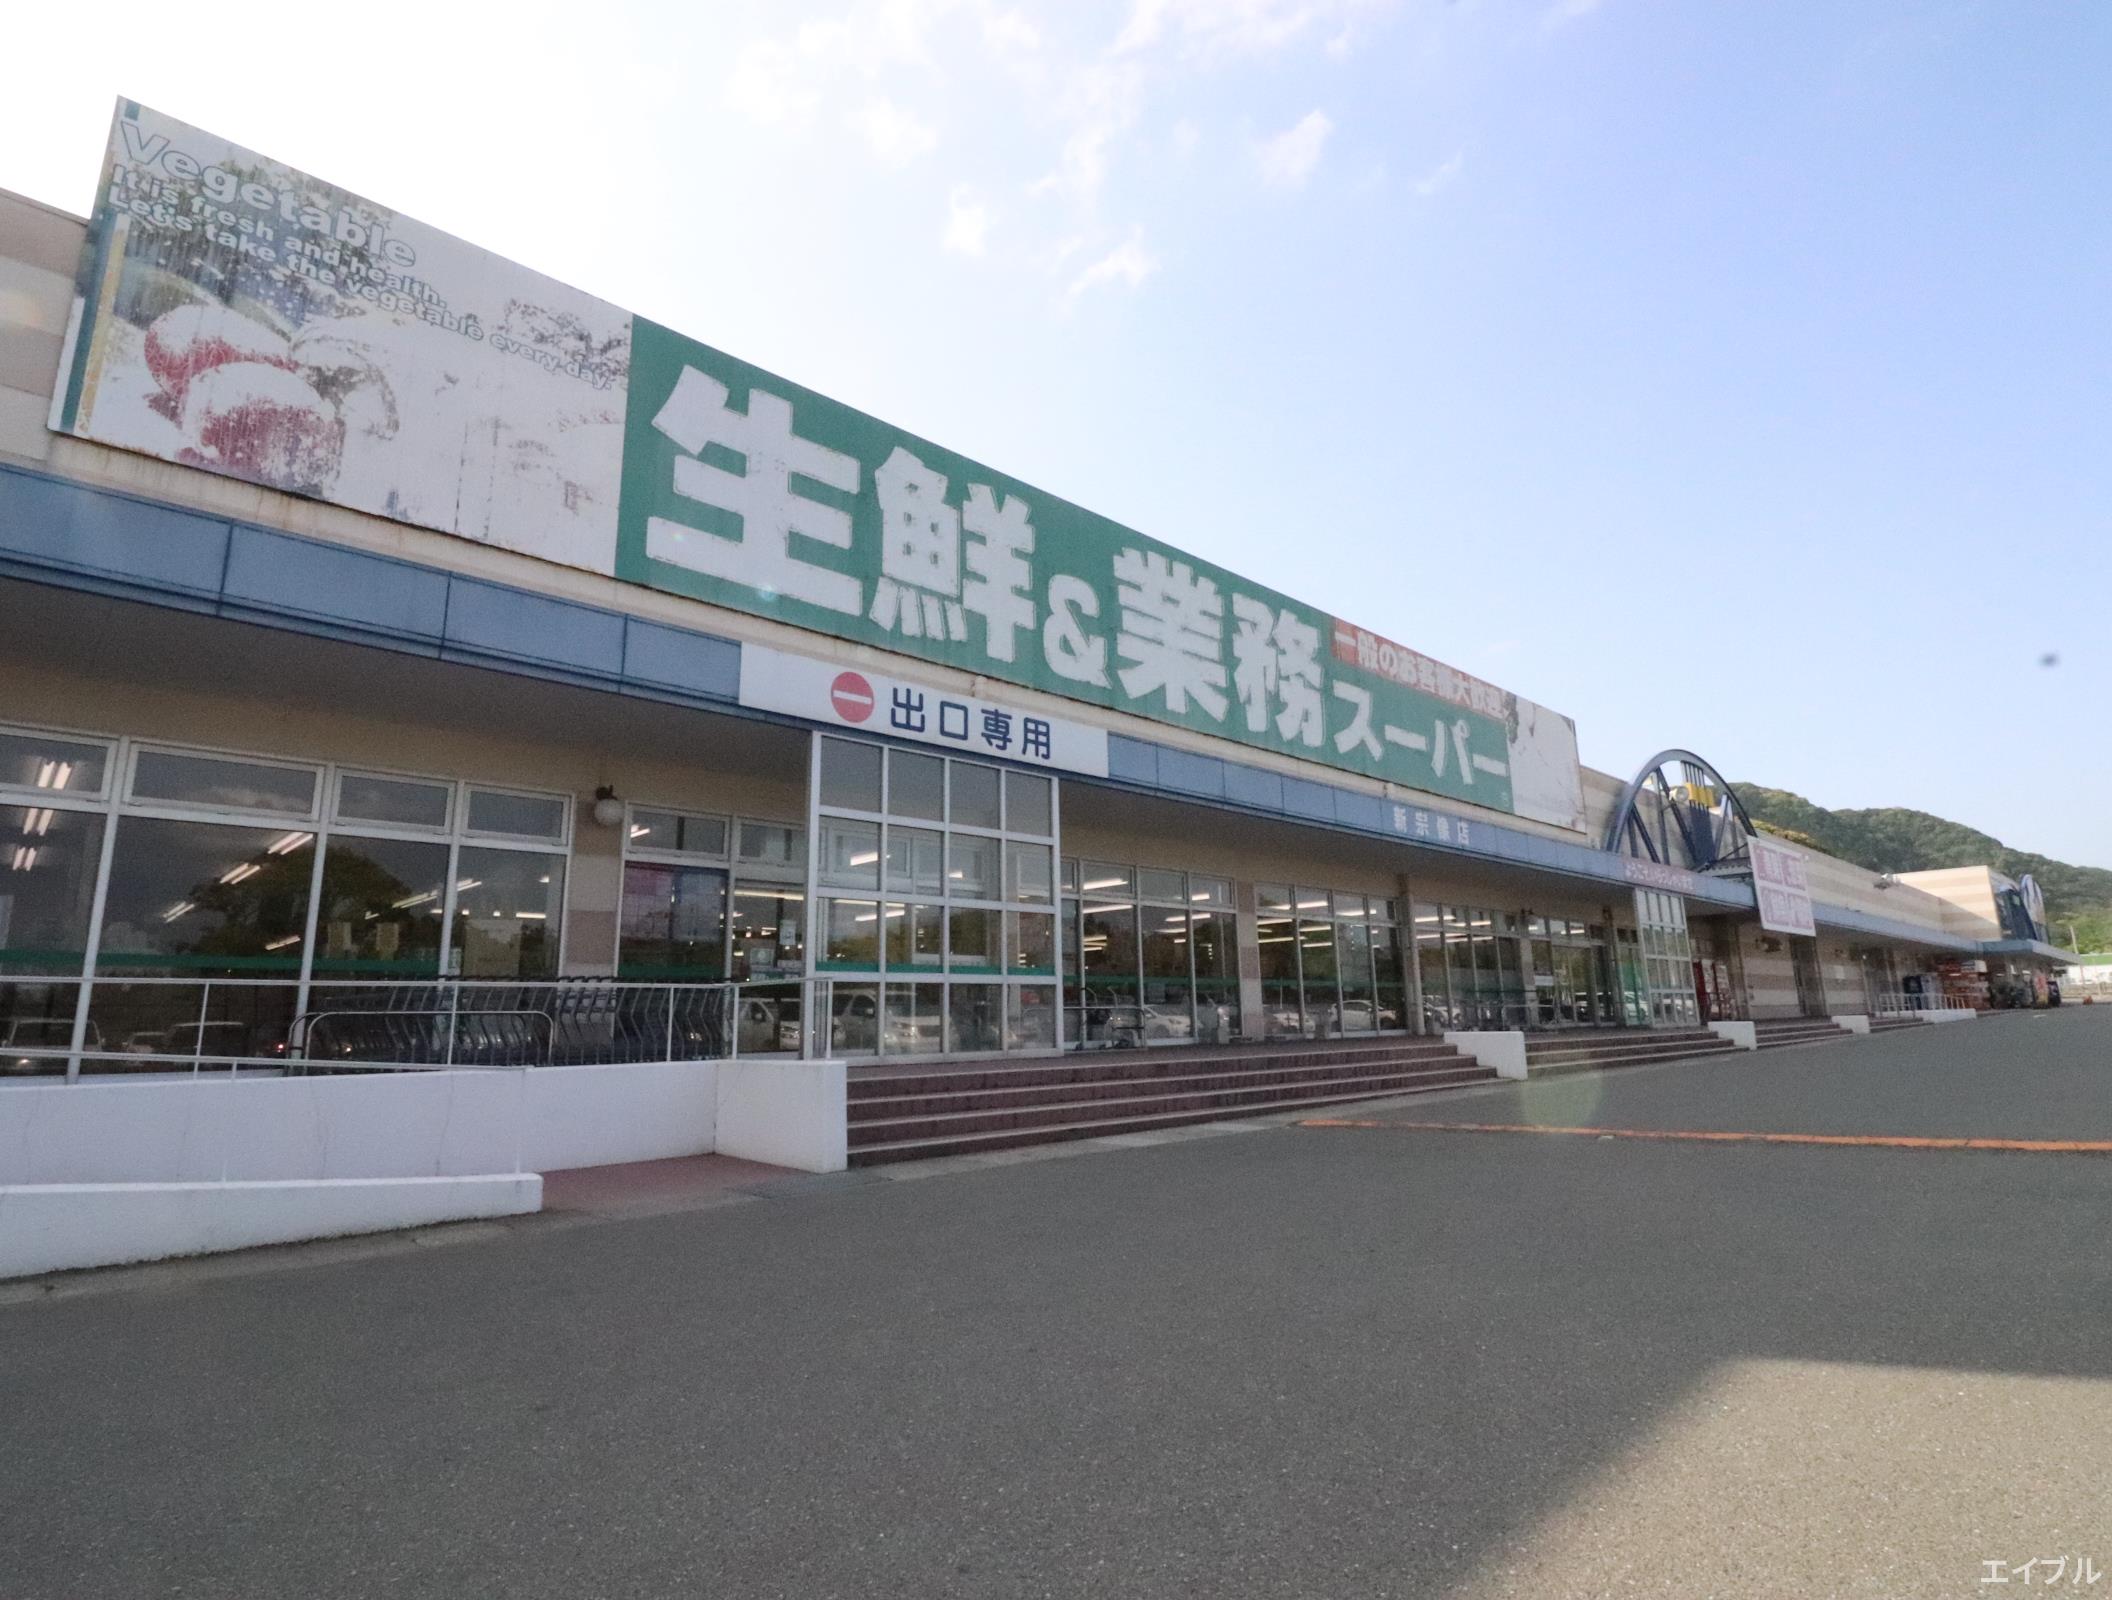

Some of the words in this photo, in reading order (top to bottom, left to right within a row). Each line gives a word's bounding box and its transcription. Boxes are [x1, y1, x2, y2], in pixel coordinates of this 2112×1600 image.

[113, 164, 140, 190] It
[150, 177, 179, 205] is
[191, 196, 274, 241] fresh
[284, 235, 341, 266] and
[350, 255, 447, 308] health.
[120, 120, 416, 267] Vegetable
[205, 223, 276, 261] take
[286, 253, 336, 285] the
[345, 277, 484, 341] vegetable
[891, 687, 1051, 760] 出口専用
